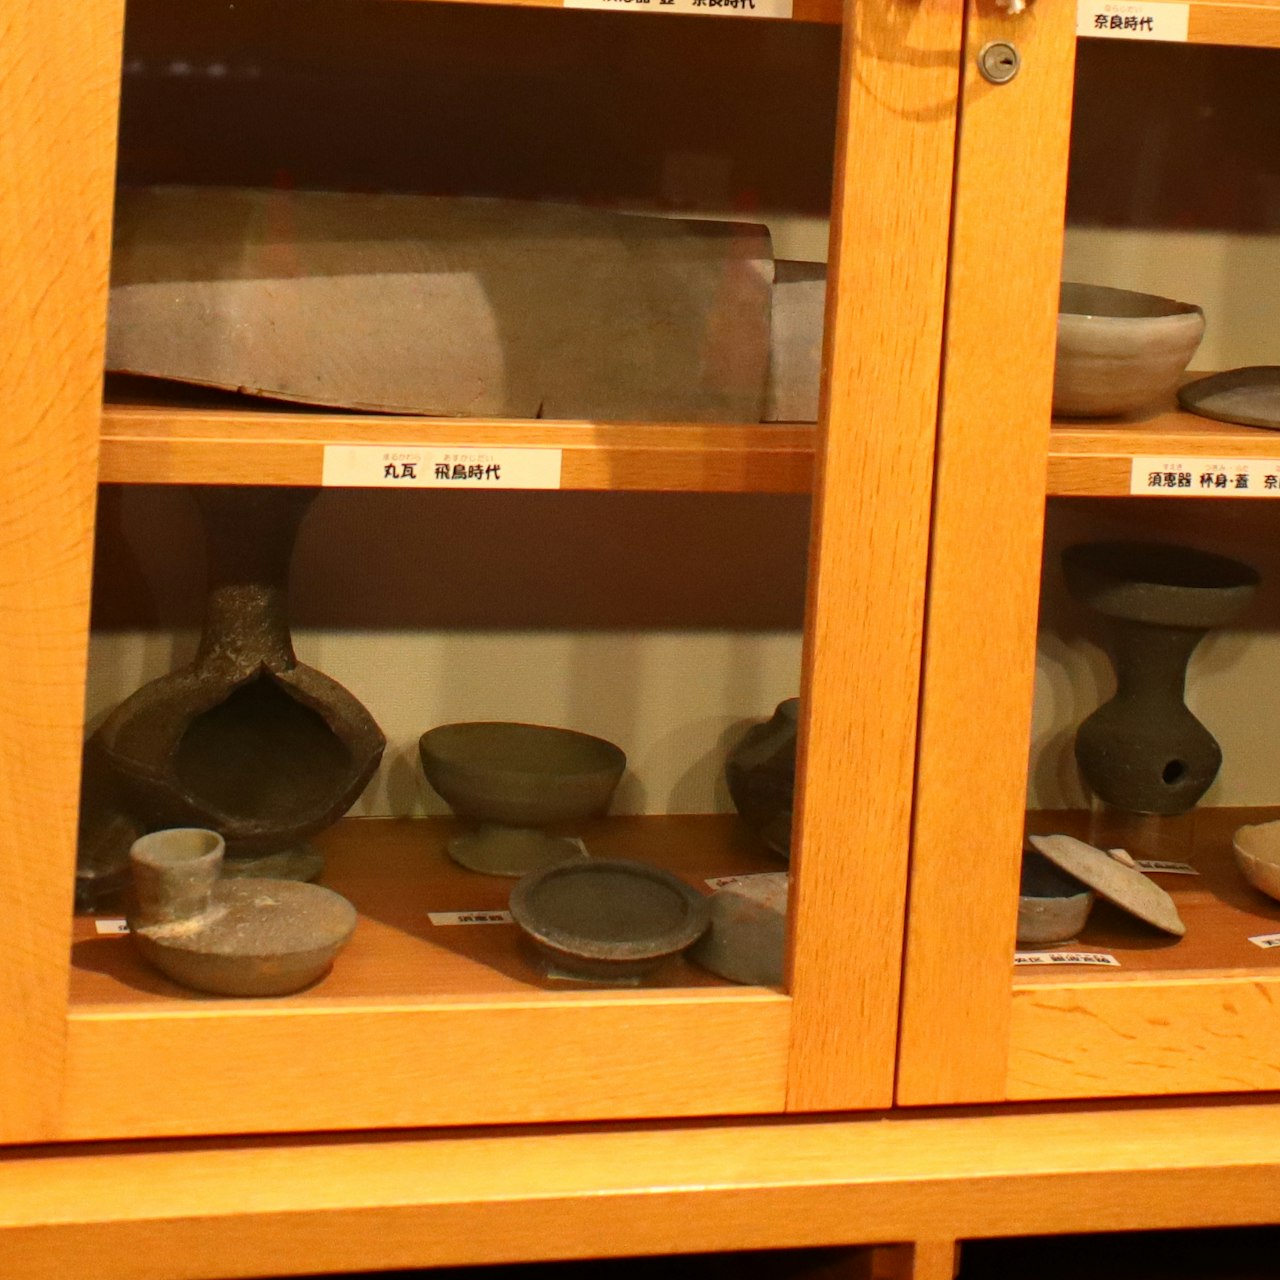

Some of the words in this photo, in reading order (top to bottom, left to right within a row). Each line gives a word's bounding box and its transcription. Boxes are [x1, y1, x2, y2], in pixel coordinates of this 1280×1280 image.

[1094, 13, 1154, 32] 奈良時代
[384, 463, 417, 478] 丸瓦
[434, 463, 501, 480] 飛鳥時代
[1148, 472, 1192, 488] 須恵器
